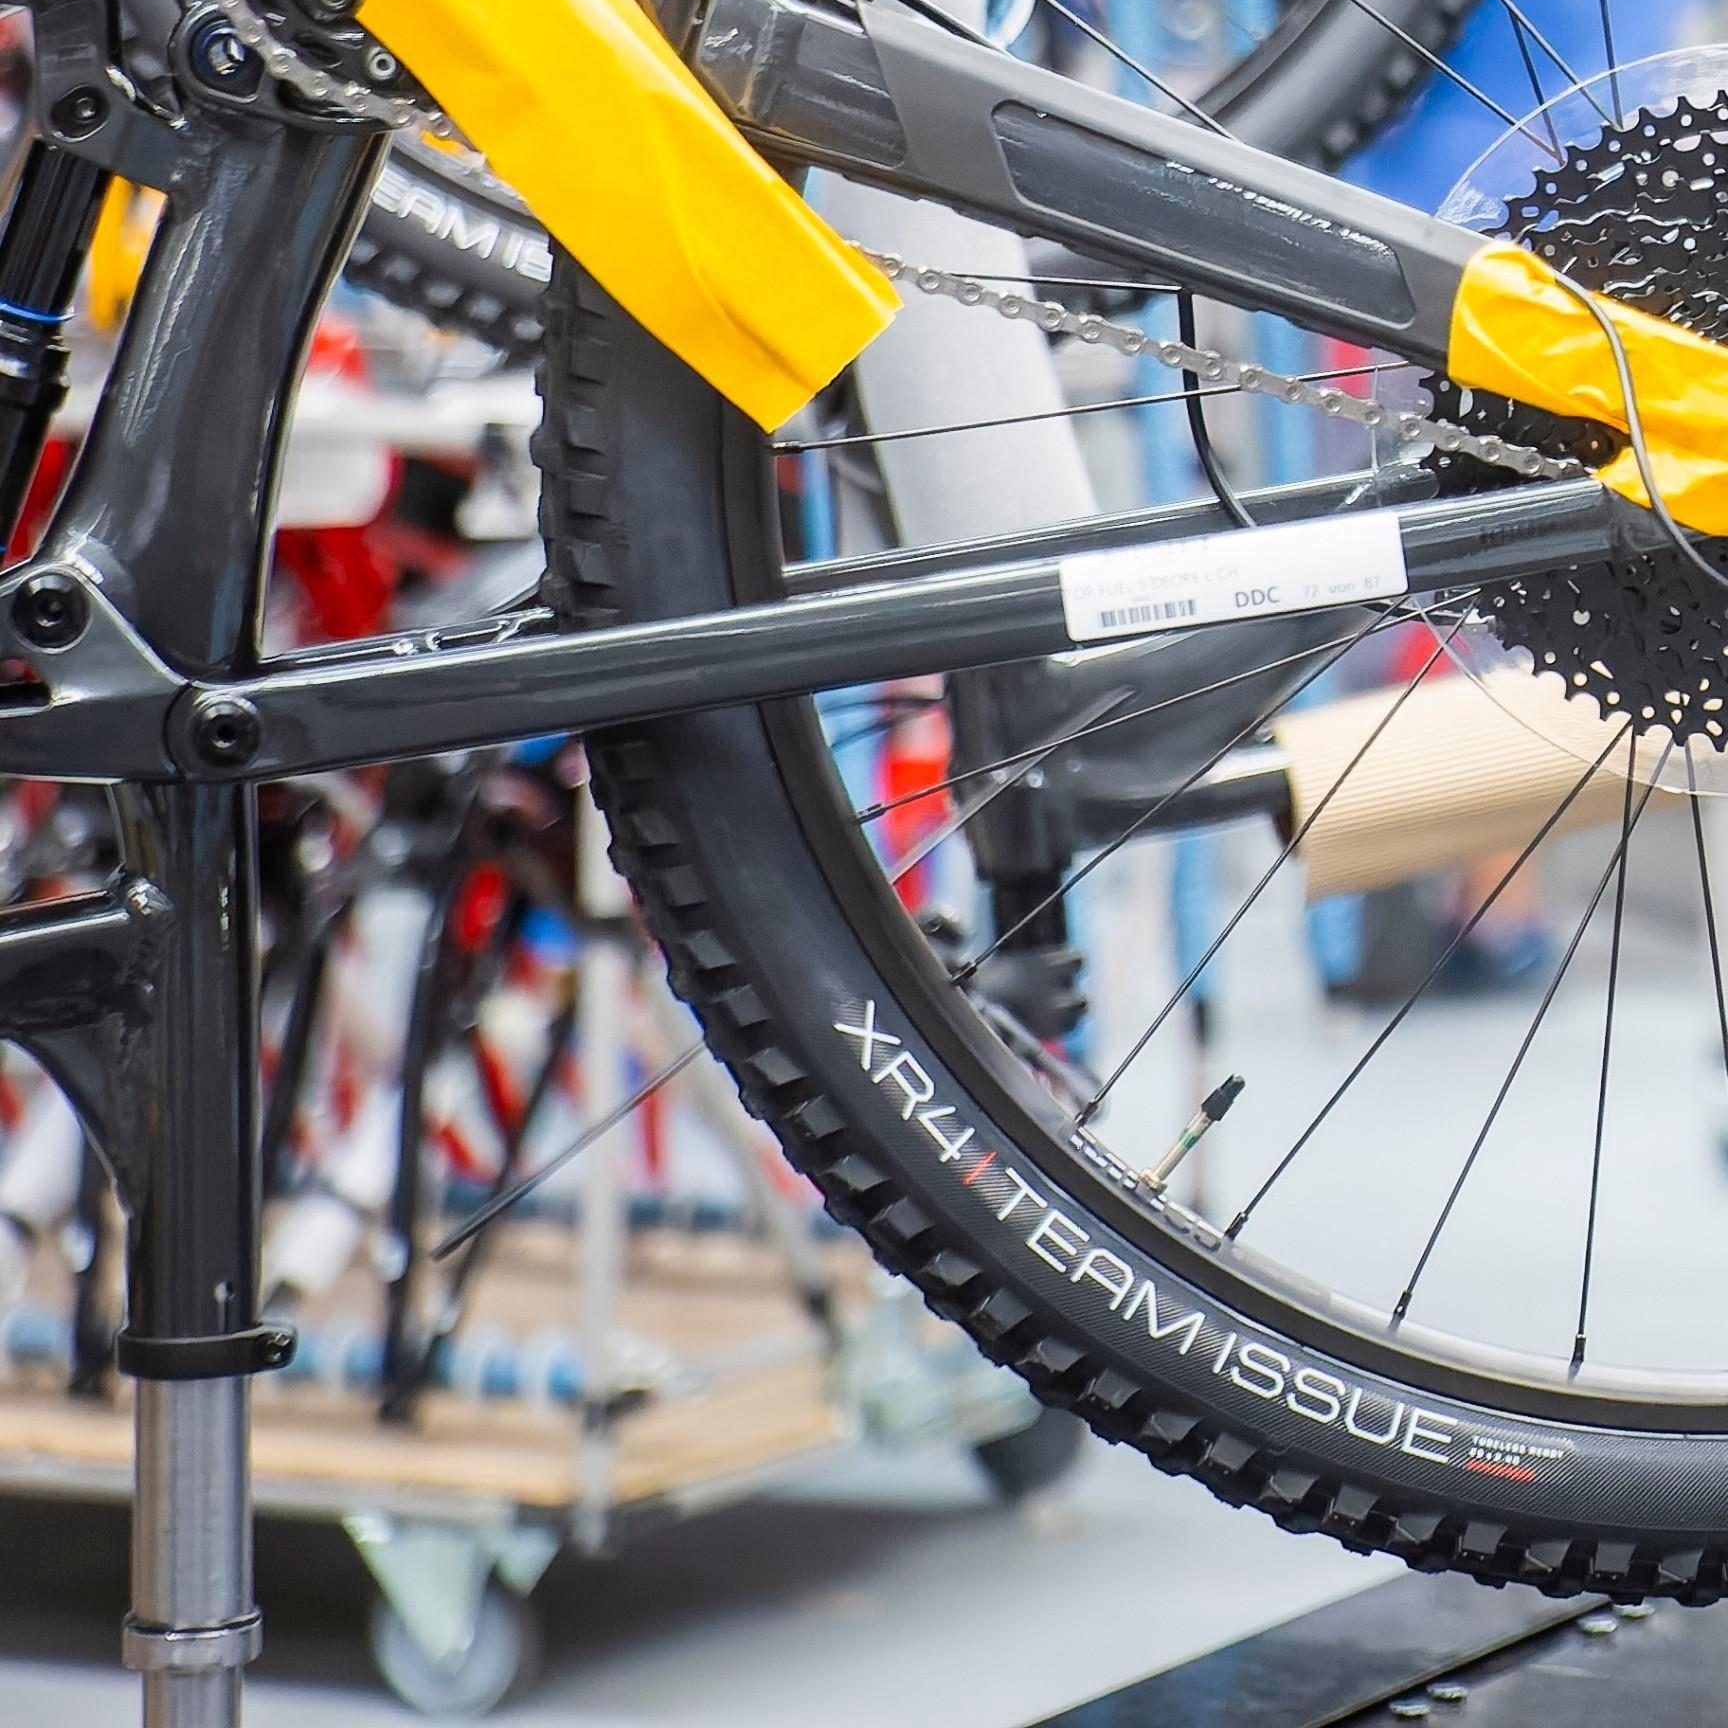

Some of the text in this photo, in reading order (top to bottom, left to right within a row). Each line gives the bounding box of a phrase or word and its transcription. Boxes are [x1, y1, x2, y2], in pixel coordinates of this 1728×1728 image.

[371, 165, 501, 262] EAM
[1234, 585, 1281, 609] DDC
[833, 1000, 978, 1163] XR4
[996, 1166, 1207, 1357] TEAM
[1212, 1330, 1460, 1464] ISSUE
